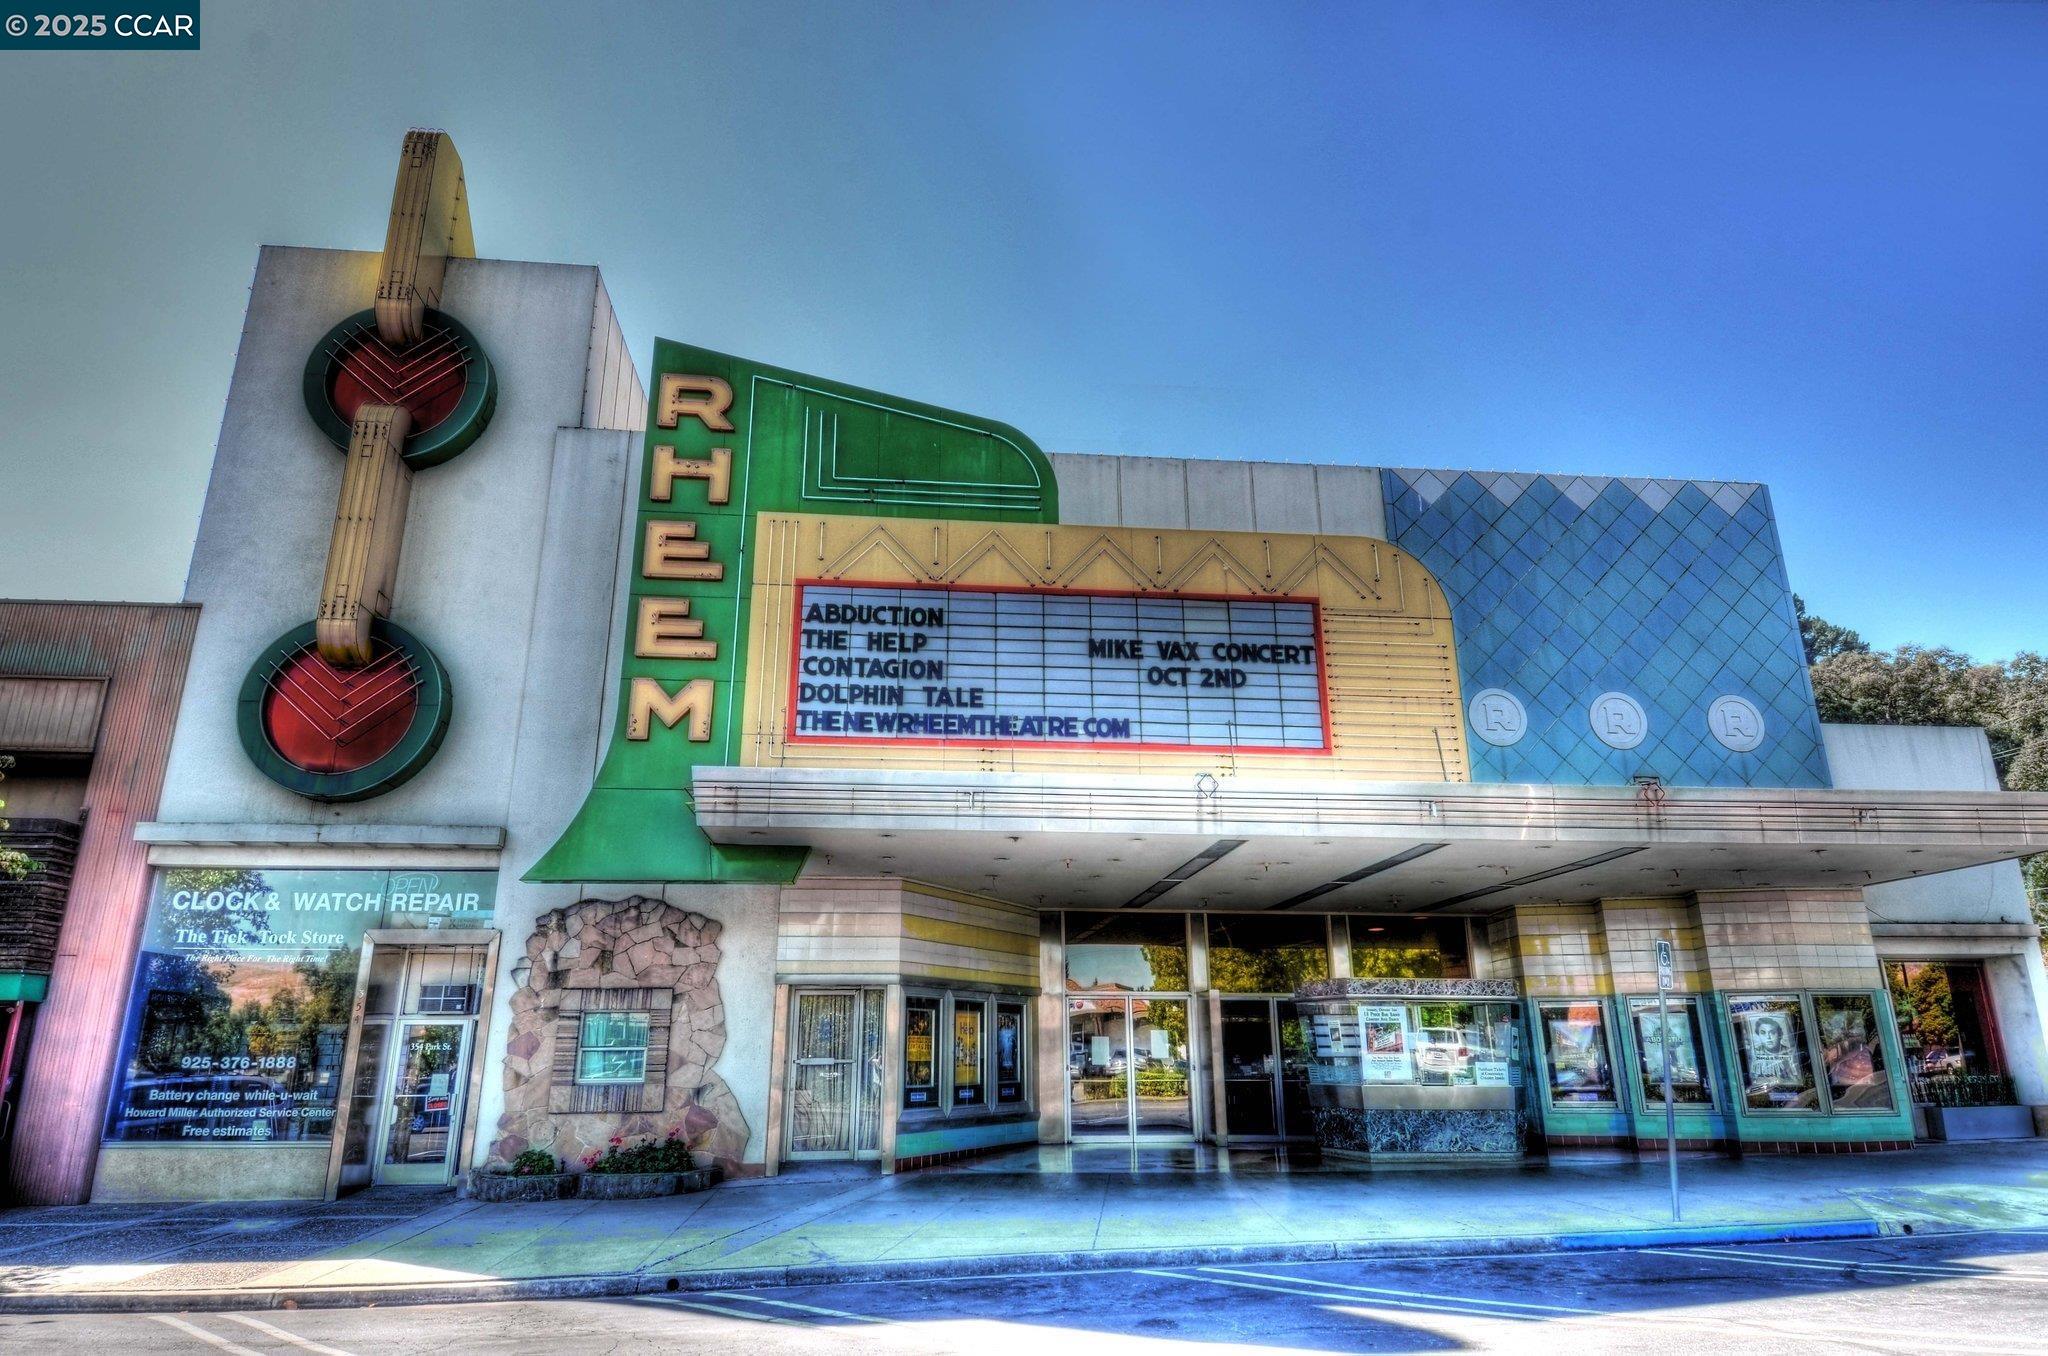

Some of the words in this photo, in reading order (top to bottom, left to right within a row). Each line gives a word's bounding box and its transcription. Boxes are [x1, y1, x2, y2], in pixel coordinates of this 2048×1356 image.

[626, 373, 735, 742] RHEEM
[805, 602, 944, 628] ABDUCTION
[803, 629, 848, 650] THE
[867, 631, 928, 653] HELP
[1088, 638, 1144, 660] MIKE
[1156, 640, 1200, 662] VAX
[1212, 642, 1314, 665] CONCERT
[803, 655, 944, 681] CONTAGION
[1147, 666, 1191, 687] OCT
[1200, 668, 1248, 689] 2ND
[800, 682, 904, 706] DOLPHIN
[922, 686, 984, 708] TALE
[173, 890, 262, 912] CLOCK
[264, 891, 281, 911] &
[293, 892, 382, 912] WATCH
[391, 893, 480, 912] REPAIR
[175, 929, 208, 944] The
[211, 929, 248, 944] Tick
[258, 930, 297, 945] Tock
[301, 929, 345, 945] Store
[185, 954, 200, 963] The
[201, 954, 224, 964] Right
[224, 954, 246, 963] Place
[247, 954, 263, 963] For
[267, 954, 281, 963] The
[282, 955, 303, 965] Right
[305, 954, 328, 963] Time!
[410, 1042, 424, 1051] 354
[425, 1042, 441, 1052] Park
[181, 1056, 297, 1070] 925-376-1888
[149, 1089, 195, 1102] Battery
[196, 1090, 241, 1102] change
[244, 1089, 318, 1101] while-u-wait
[124, 1106, 167, 1118] Howard
[167, 1107, 197, 1118] Miller
[199, 1106, 256, 1118] Authorized
[258, 1107, 299, 1118] Service
[300, 1107, 337, 1118] Center
[181, 1125, 210, 1137] Free
[212, 1125, 272, 1137] estimates
